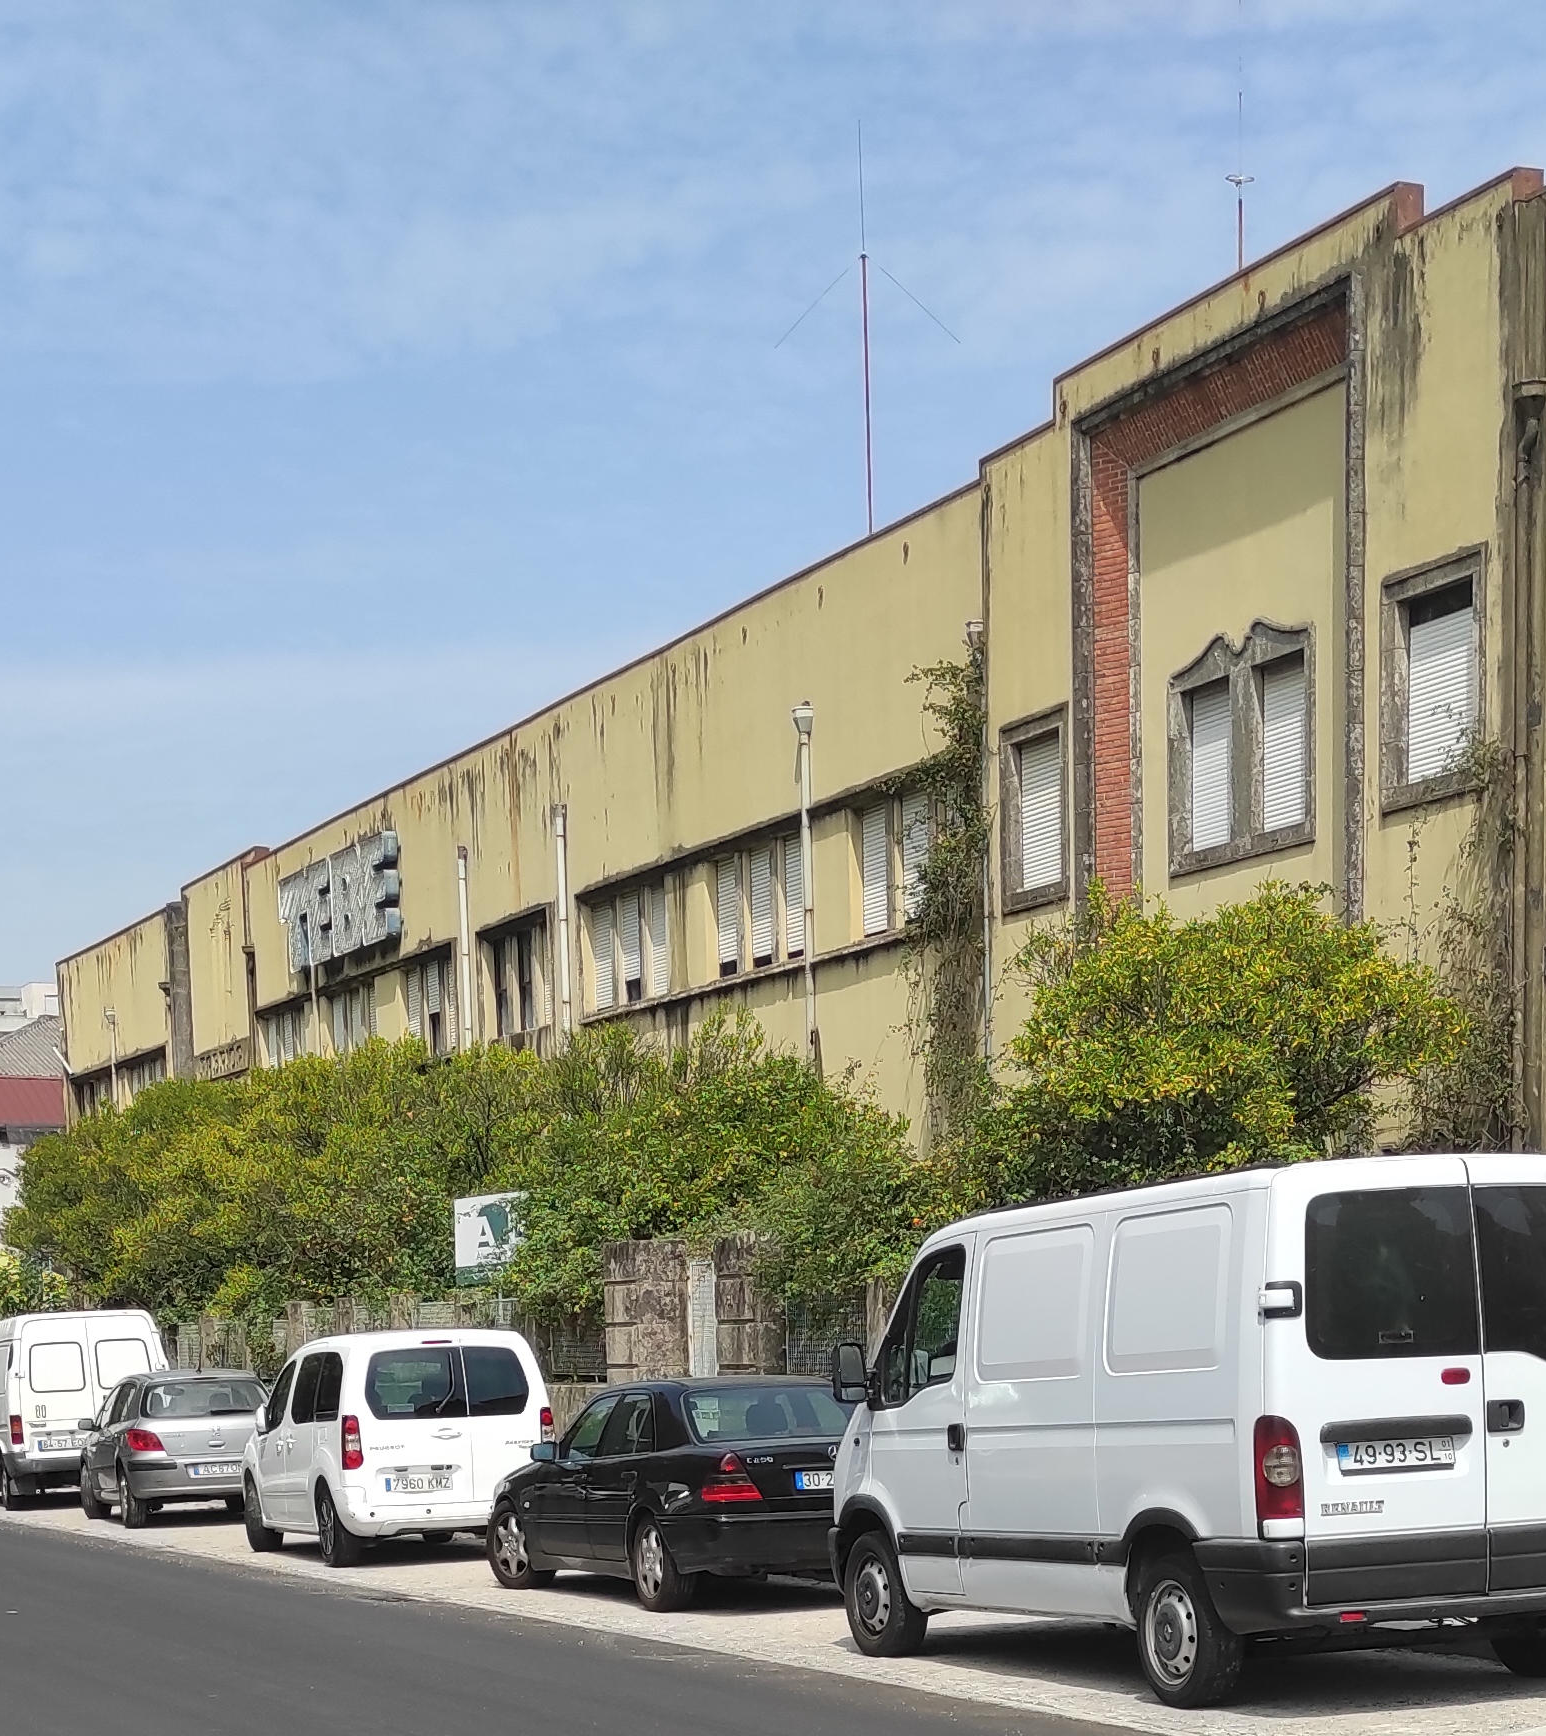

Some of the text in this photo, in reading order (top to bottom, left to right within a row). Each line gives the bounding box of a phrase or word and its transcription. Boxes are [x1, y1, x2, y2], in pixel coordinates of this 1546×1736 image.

[393, 1476, 451, 1491] 7960 KMZ
[1320, 1499, 1385, 1517] RENAULT
